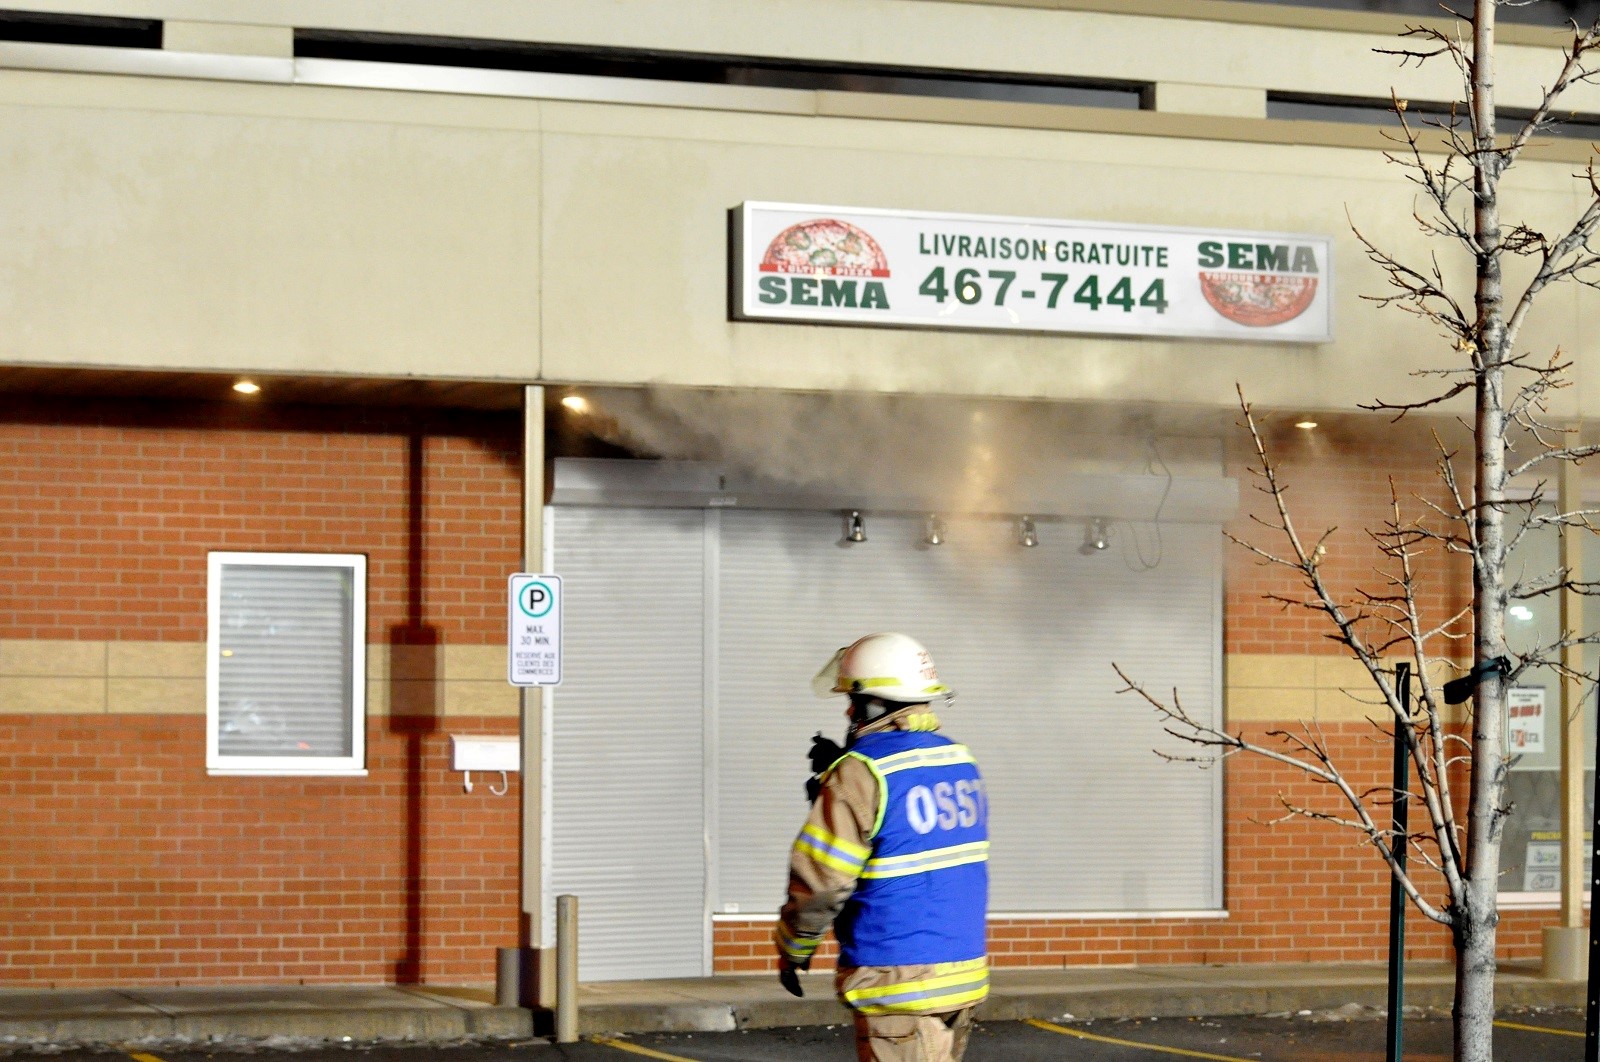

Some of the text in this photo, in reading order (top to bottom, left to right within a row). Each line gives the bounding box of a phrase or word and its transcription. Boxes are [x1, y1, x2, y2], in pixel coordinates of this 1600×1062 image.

[919, 232, 1169, 268] LIVRAISON GRATUITE
[1197, 240, 1319, 274] SEMA
[836, 267, 873, 277] PIZZA
[758, 276, 891, 310] SEMA
[918, 265, 1169, 314] 467-7444
[529, 589, 545, 610] P
